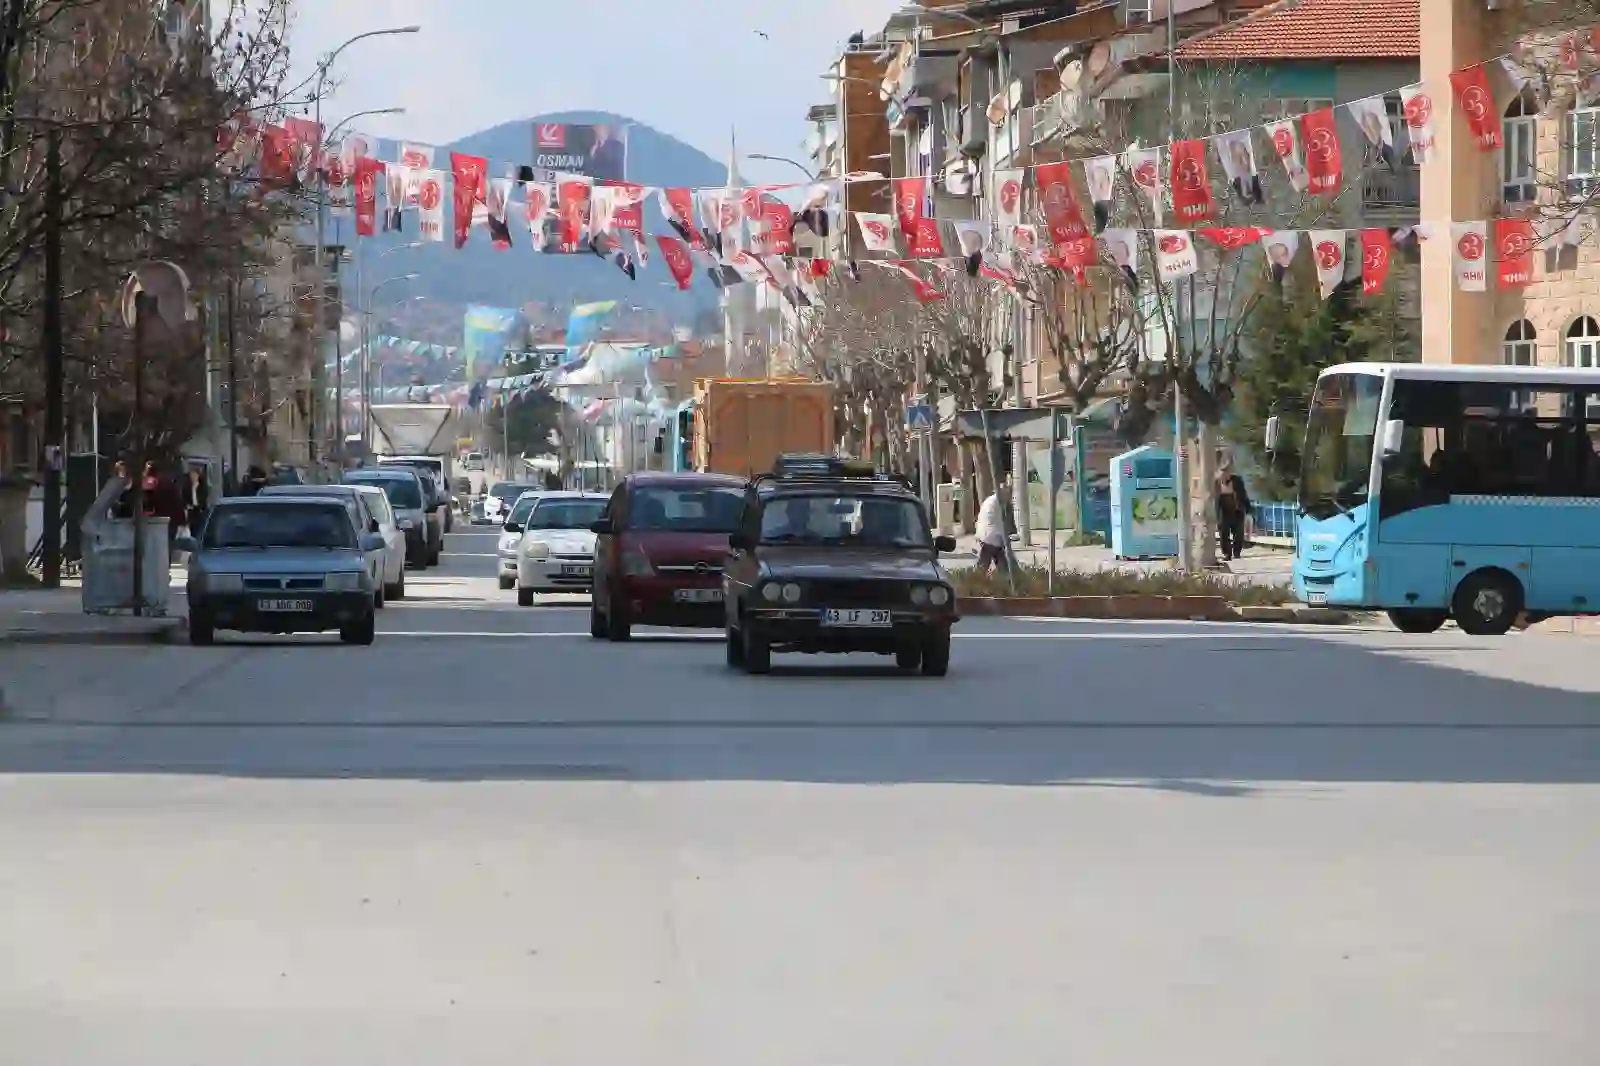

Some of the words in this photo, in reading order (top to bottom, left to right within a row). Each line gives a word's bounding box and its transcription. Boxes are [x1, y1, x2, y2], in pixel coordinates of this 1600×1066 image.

[536, 154, 585, 168] OSMAN
[826, 610, 840, 623] 43
[848, 610, 861, 623] LF
[871, 610, 890, 624] 297
